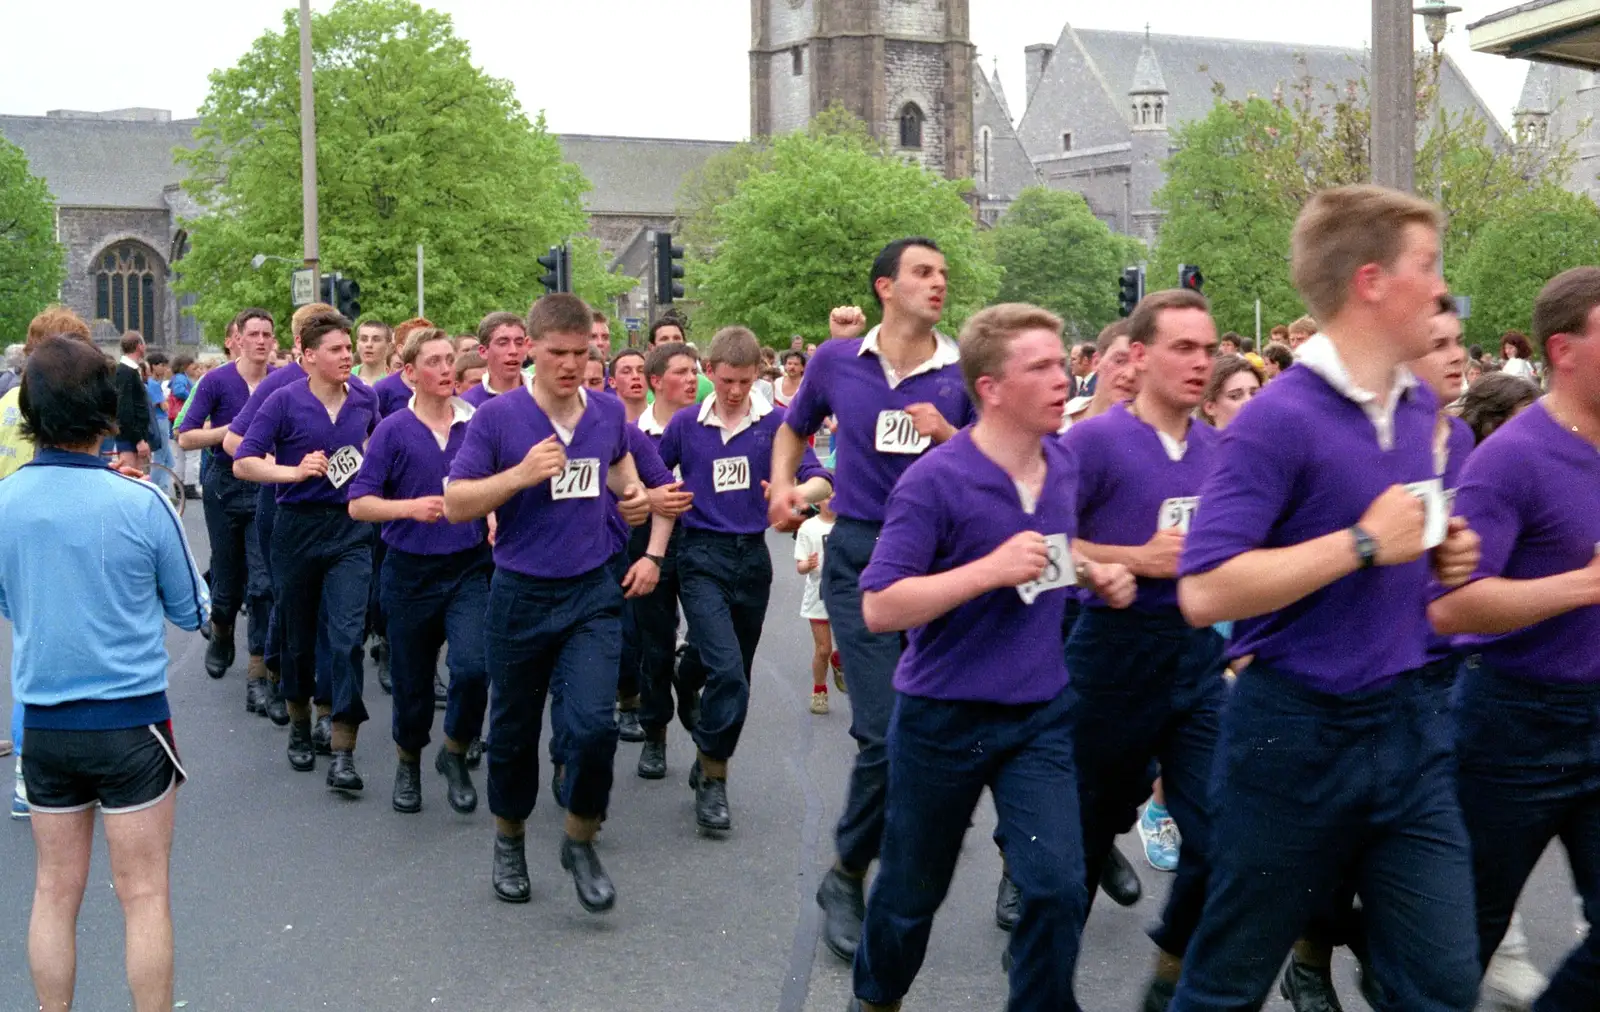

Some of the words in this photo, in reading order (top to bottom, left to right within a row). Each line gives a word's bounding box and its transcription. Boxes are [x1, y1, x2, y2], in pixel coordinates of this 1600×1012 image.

[330, 449, 357, 483] 265
[555, 464, 592, 493] 270
[717, 461, 747, 487] 220
